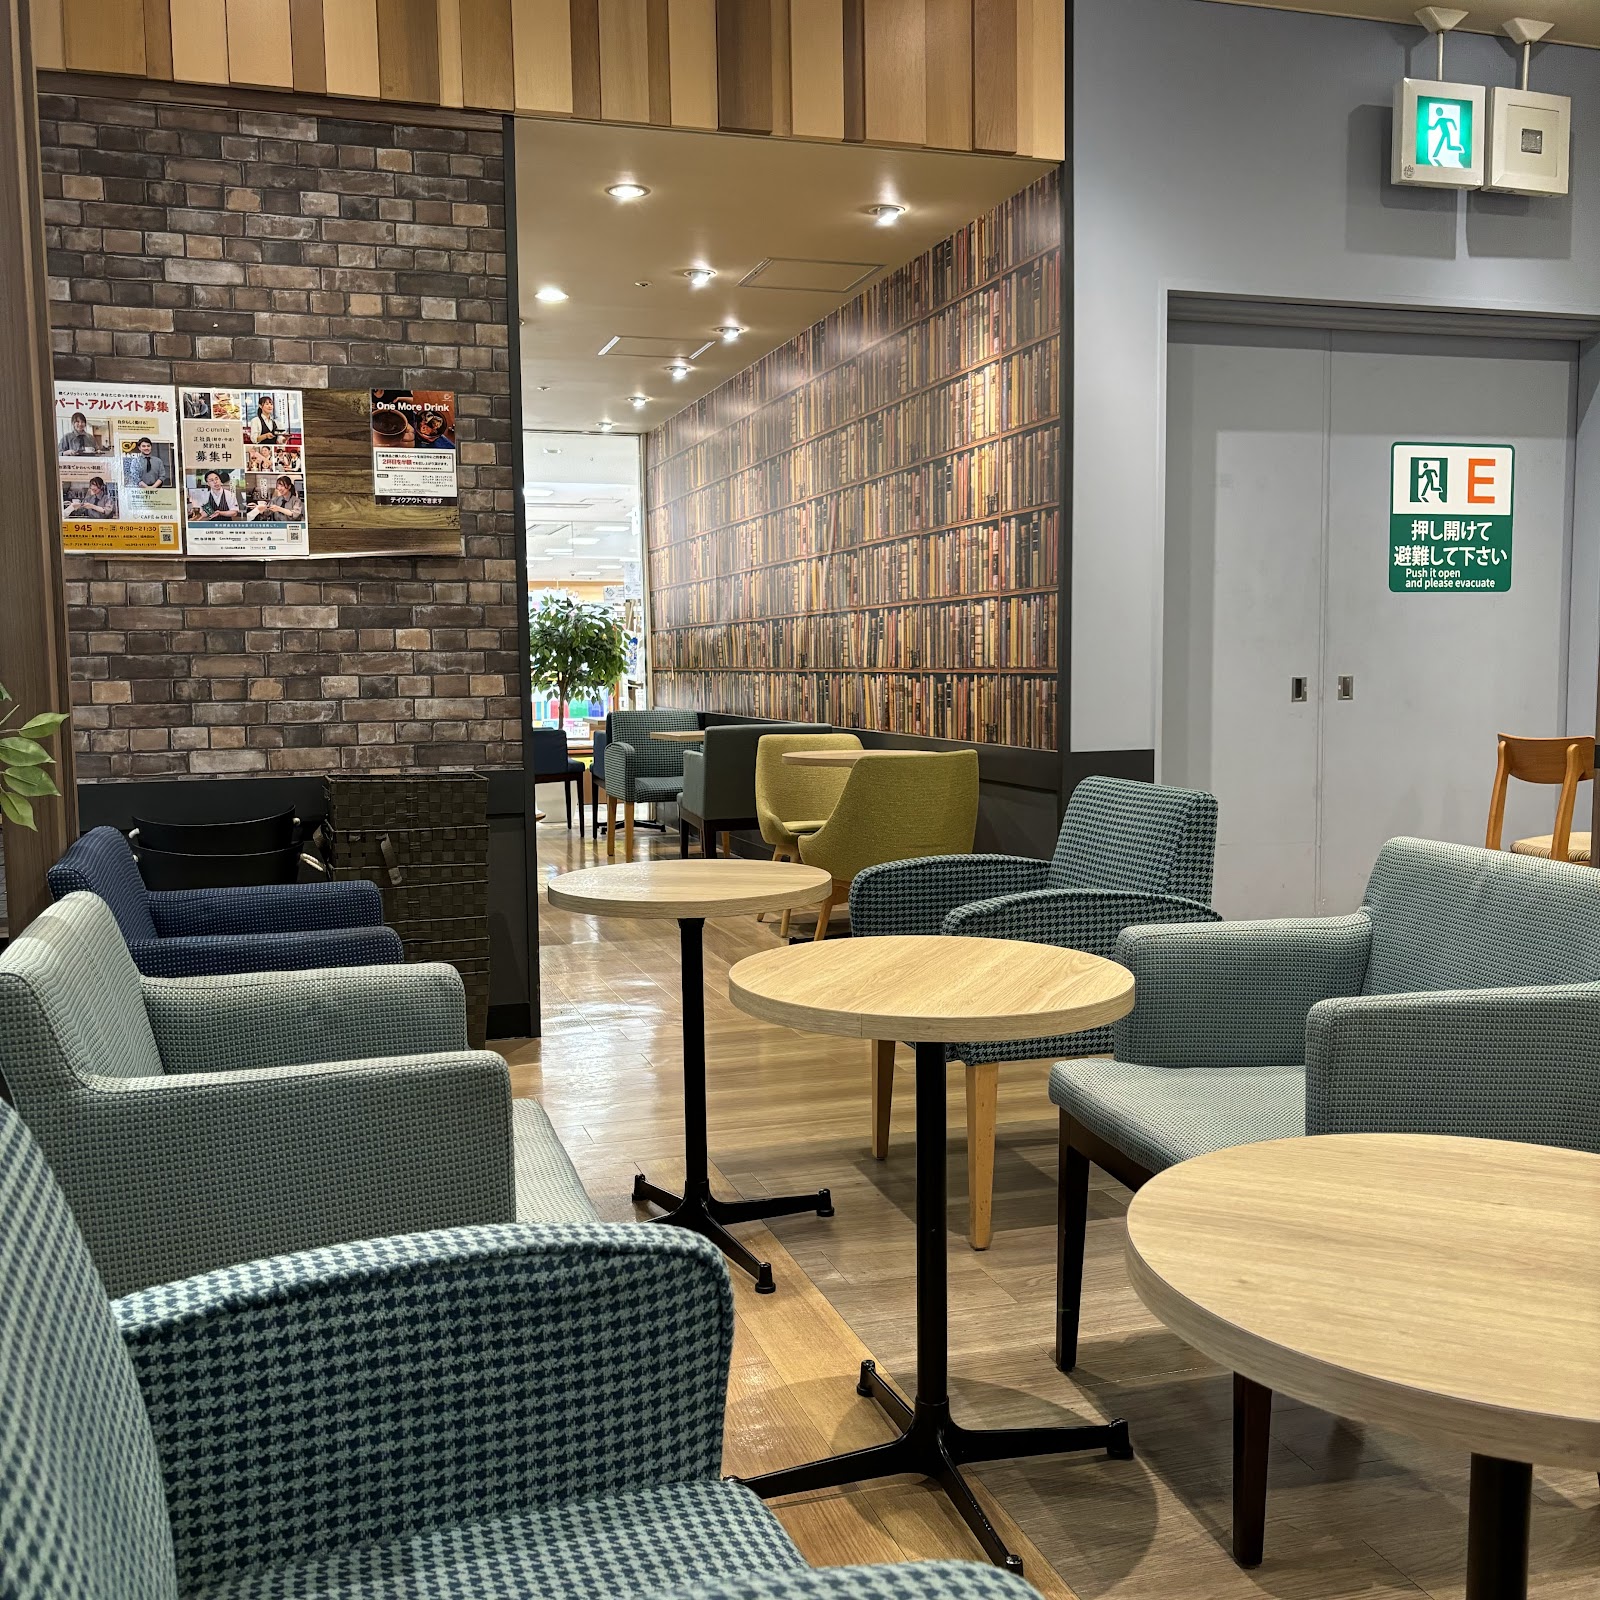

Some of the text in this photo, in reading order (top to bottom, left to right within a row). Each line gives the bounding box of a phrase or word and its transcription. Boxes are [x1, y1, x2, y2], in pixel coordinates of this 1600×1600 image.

[377, 402, 450, 412] One More Drink
[195, 450, 232, 462] 募集中
[1467, 458, 1496, 504] E
[390, 496, 443, 505] テイクアウトできます
[74, 524, 93, 532] 945
[1411, 519, 1493, 541] 押し開けて
[1394, 544, 1508, 567] 避難して下さい
[1405, 567, 1461, 580] Push it open
[1405, 577, 1496, 590] and please evacuate
